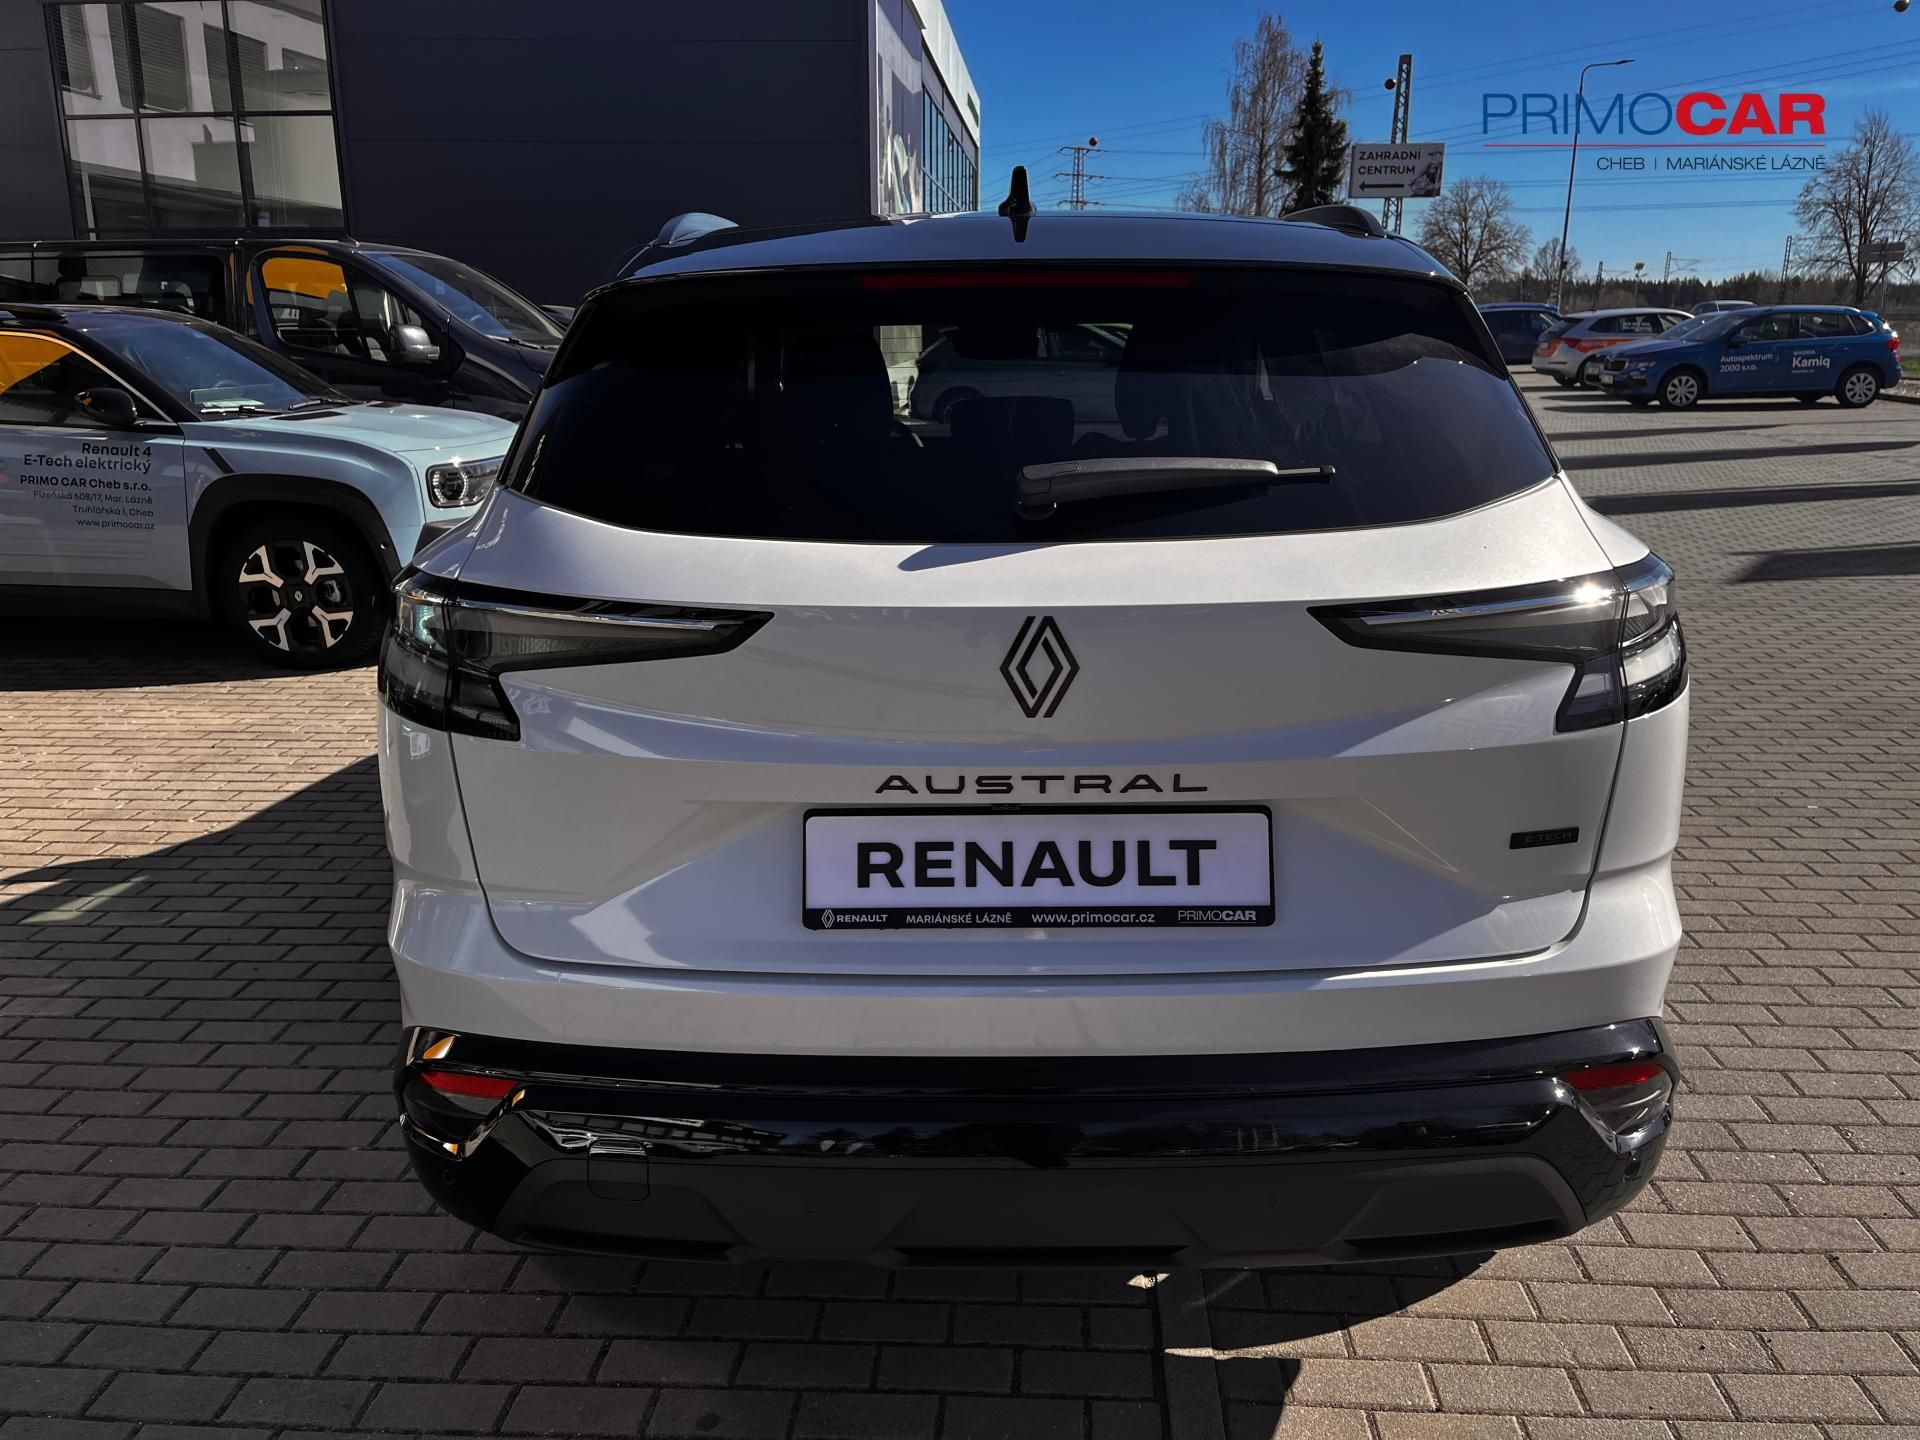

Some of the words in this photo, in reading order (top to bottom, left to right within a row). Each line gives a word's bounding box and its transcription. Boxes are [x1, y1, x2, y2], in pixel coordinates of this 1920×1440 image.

[1359, 148, 1421, 160] ZAHRADNÍ
[1358, 165, 1416, 175] CENTRUM
[1720, 352, 1773, 364] Autospektrum
[1792, 355, 1831, 368] Kamiq
[1720, 364, 1740, 372] 2000
[81, 443, 140, 457] Renault
[142, 446, 152, 457] 4
[24, 454, 72, 468] E-Tech
[75, 456, 151, 474] elektrický
[20, 475, 59, 487] PRIMO
[61, 477, 87, 488] CAR
[89, 478, 121, 489] Cheb
[123, 481, 152, 491] s.r.o.
[105, 494, 123, 503] Mar.
[129, 507, 154, 517] Cheb
[76, 519, 156, 530] www.primocar.cz
[874, 773, 1208, 795] AUSTRAL
[857, 840, 1217, 888] RENAULT
[836, 913, 888, 923] RENAULT
[906, 912, 973, 924] MARIÁNSKÉ
[975, 911, 1012, 924] LÁZNĚ
[1031, 911, 1155, 925] www.primocar.cz
[1177, 910, 1257, 922] PRIMOCAR
